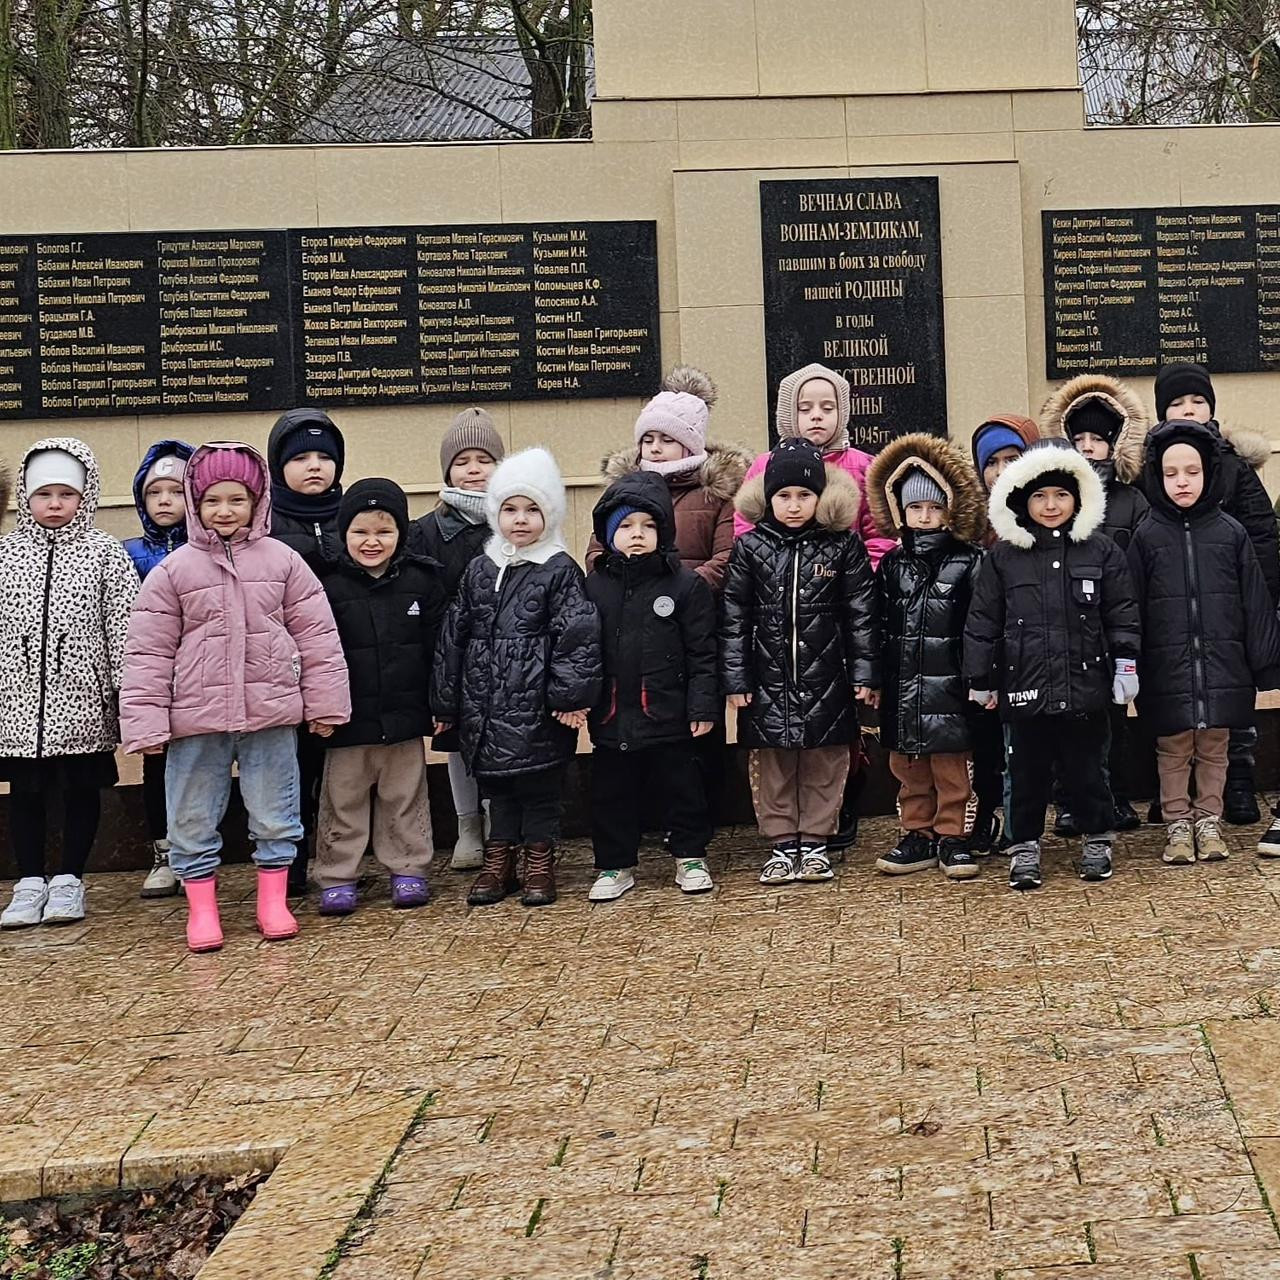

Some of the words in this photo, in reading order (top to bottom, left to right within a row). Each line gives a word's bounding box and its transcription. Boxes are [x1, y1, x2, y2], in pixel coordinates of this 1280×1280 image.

[799, 193, 853, 211] ВЕЧНАЯ
[857, 192, 902, 210] СЛАВА
[780, 221, 923, 242] ВОИНАМ-ЗЕМЛЯКАМ,
[301, 236, 328, 250] Егоров
[329, 235, 363, 249] Тимофей
[364, 235, 406, 248] Федорович
[37, 259, 70, 271] Бабакин
[71, 258, 104, 270] Алексей
[105, 258, 143, 269] Иванович
[779, 257, 826, 271] павшим
[829, 257, 836, 270] в
[839, 252, 865, 269] боях
[868, 256, 879, 268] за
[883, 250, 926, 272] свободу
[804, 282, 842, 300] нашей
[845, 279, 903, 300] РОДИНЫ
[535, 313, 565, 323] Костин
[566, 311, 584, 323] Н.П.
[836, 316, 843, 328] в
[845, 314, 874, 329] годы
[536, 329, 565, 340] Костин
[567, 328, 593, 339] Павел
[595, 327, 648, 341] Григорьевич
[824, 334, 888, 358] ВЕЛИКОЙ
[537, 378, 563, 391] Карев
[564, 377, 581, 388] Н.А.
[851, 393, 883, 415] ЙНЫ
[154, 459, 173, 476] C
[813, 563, 838, 578] Dior
